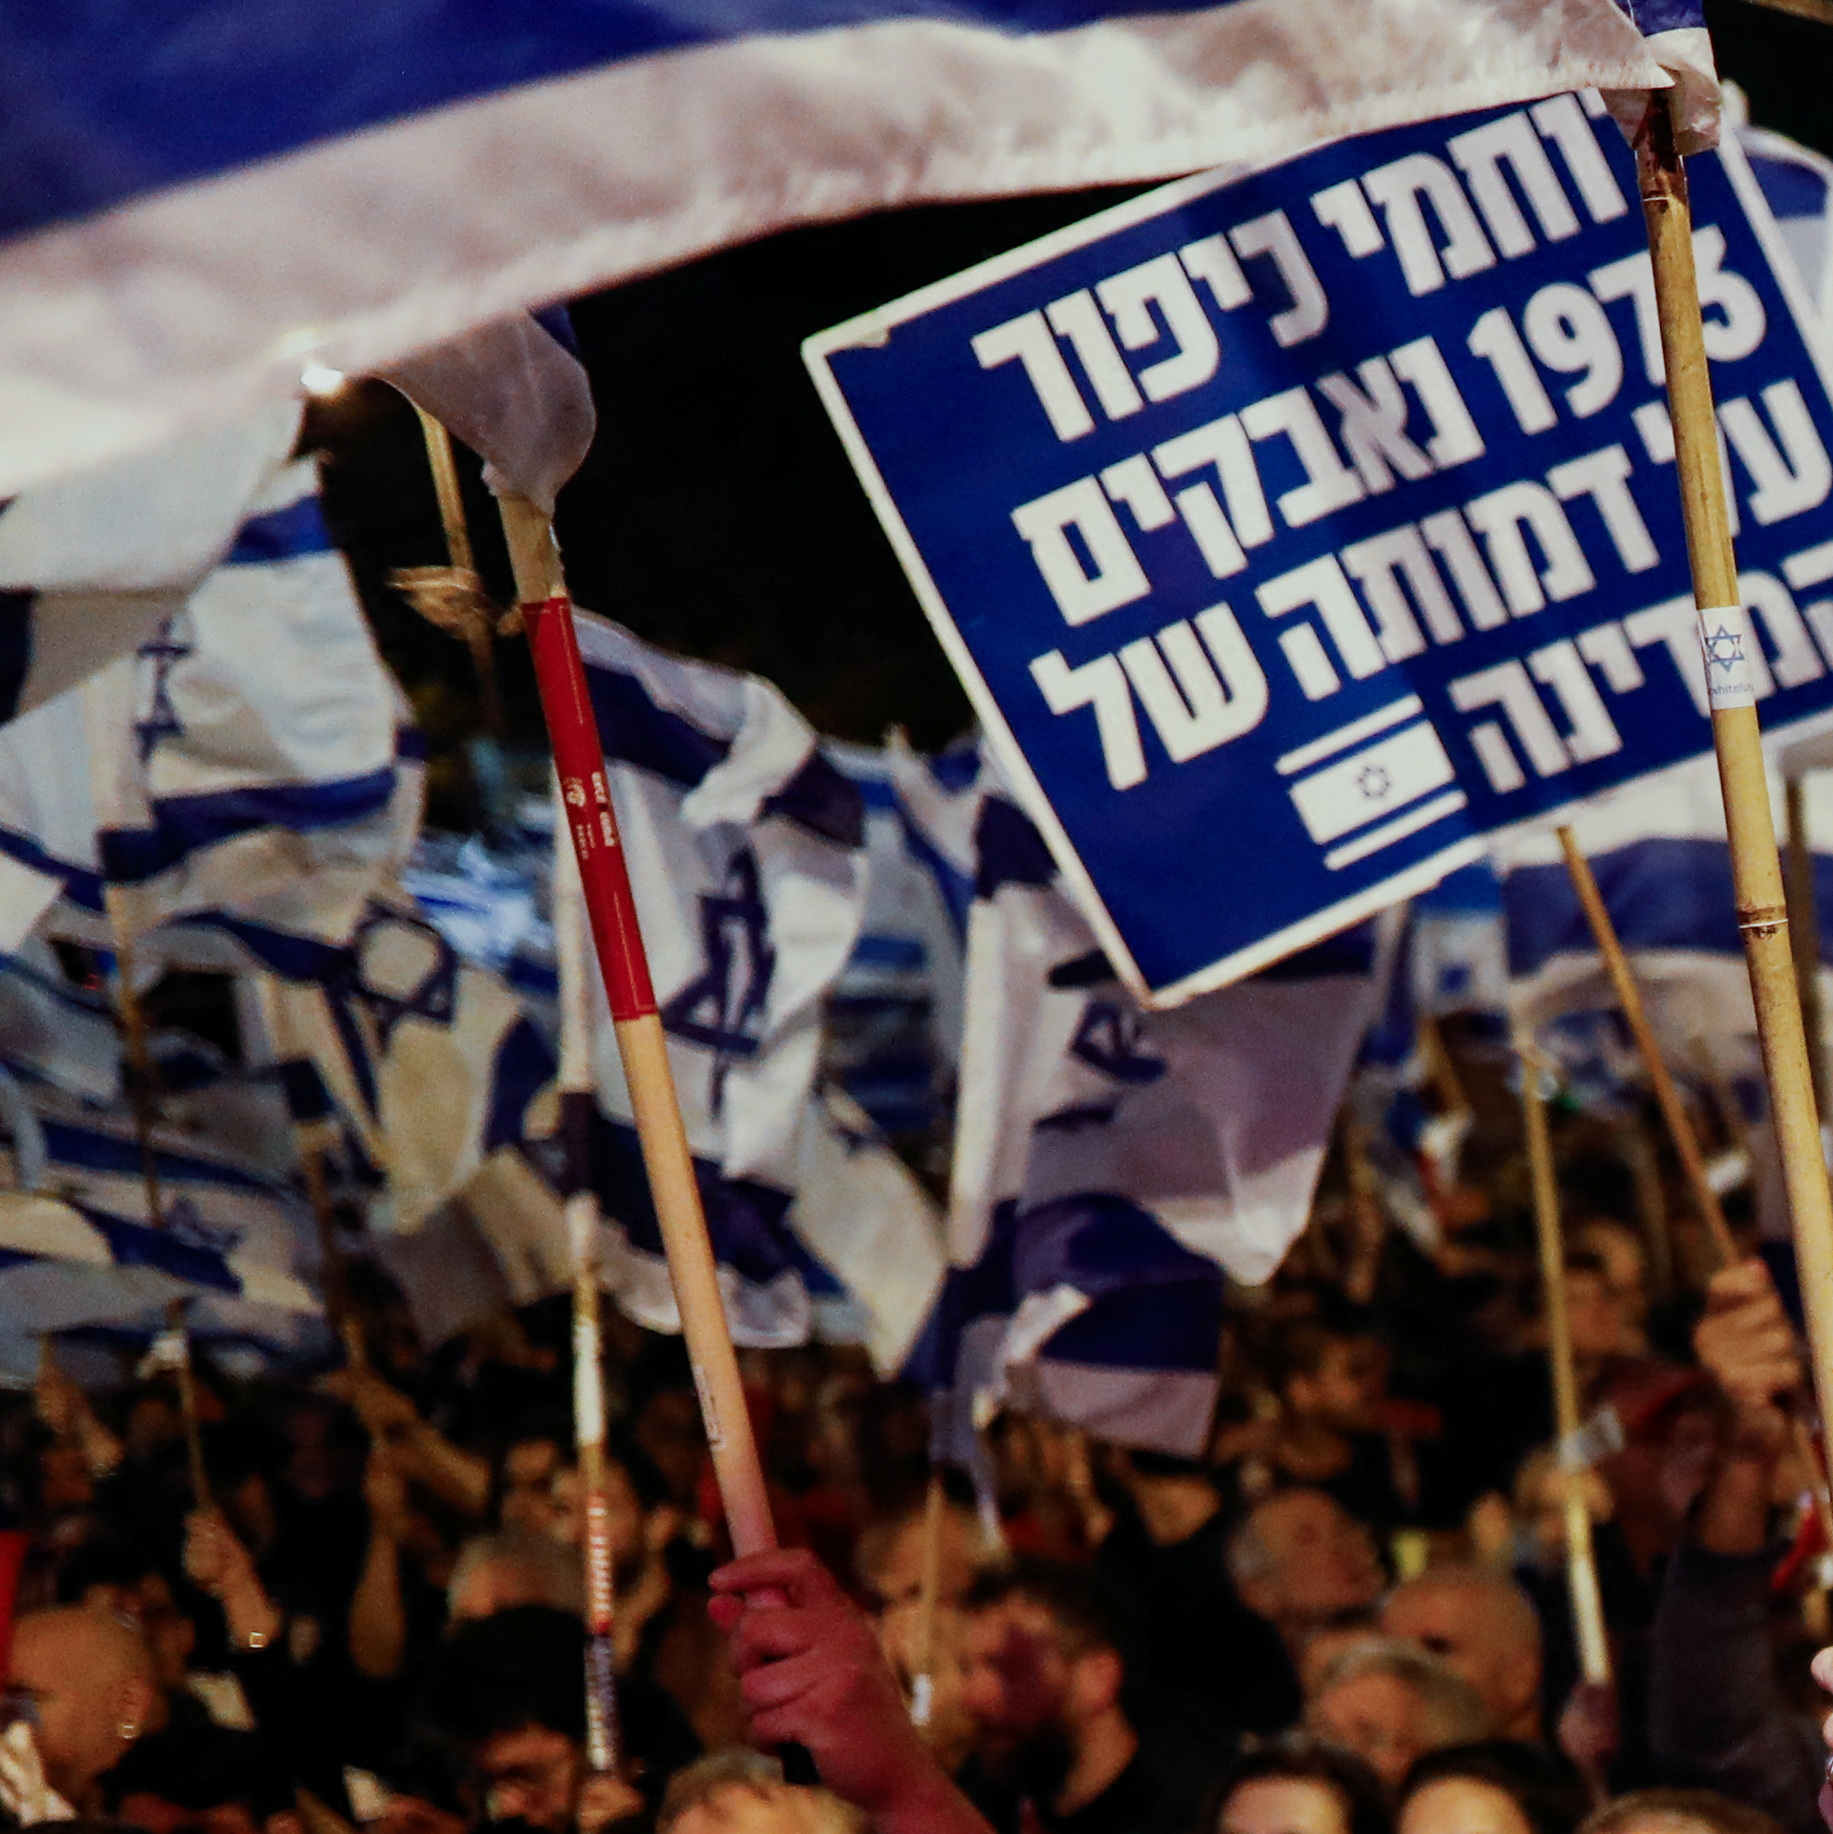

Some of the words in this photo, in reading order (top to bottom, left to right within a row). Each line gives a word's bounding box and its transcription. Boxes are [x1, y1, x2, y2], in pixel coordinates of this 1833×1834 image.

[1310, 88, 1629, 297] וחמי
[971, 209, 1330, 442] כיפור
[1466, 224, 1767, 436] 1973
[1011, 336, 1486, 628] נאבקים
[1255, 444, 1661, 701] דמותה
[1029, 601, 1269, 790] של
